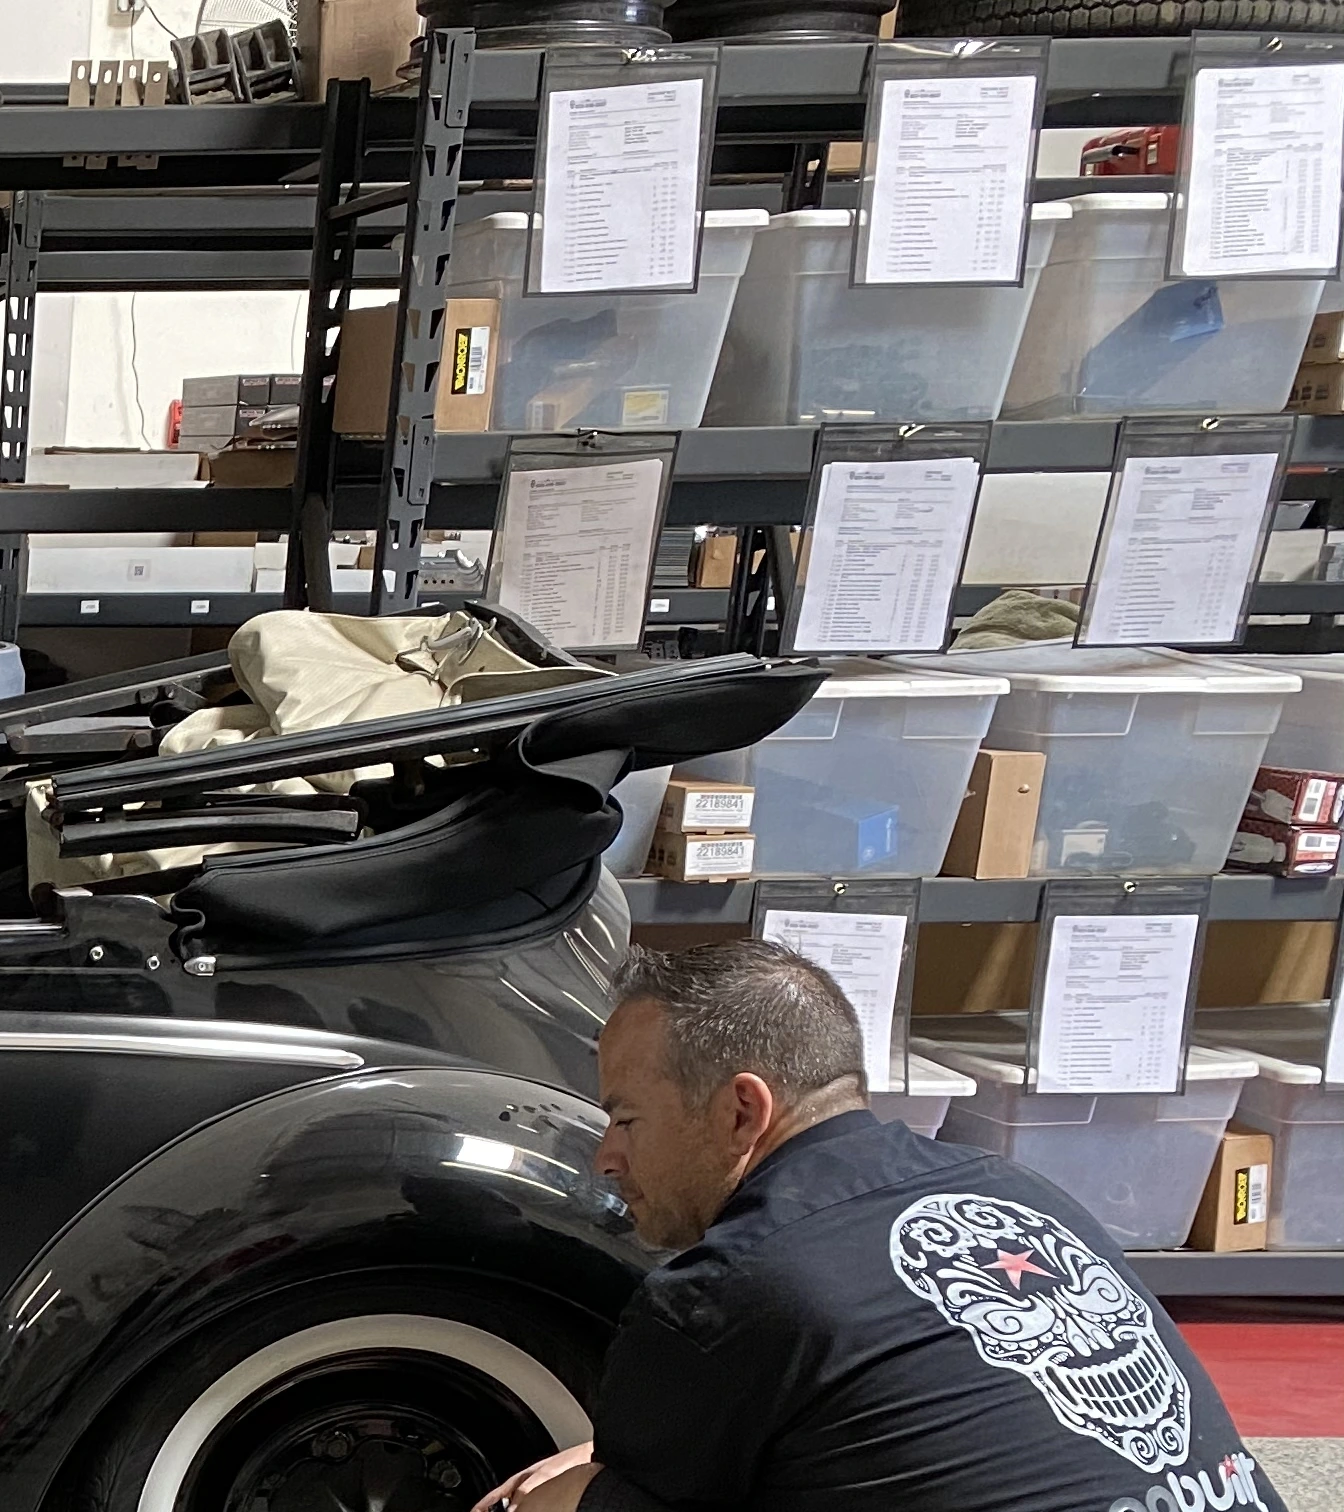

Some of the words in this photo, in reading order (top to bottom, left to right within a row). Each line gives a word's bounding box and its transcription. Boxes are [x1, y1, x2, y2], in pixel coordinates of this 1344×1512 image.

[454, 333, 468, 391] MONROE
[695, 798, 744, 809] 22189841
[696, 846, 745, 857] 22189841
